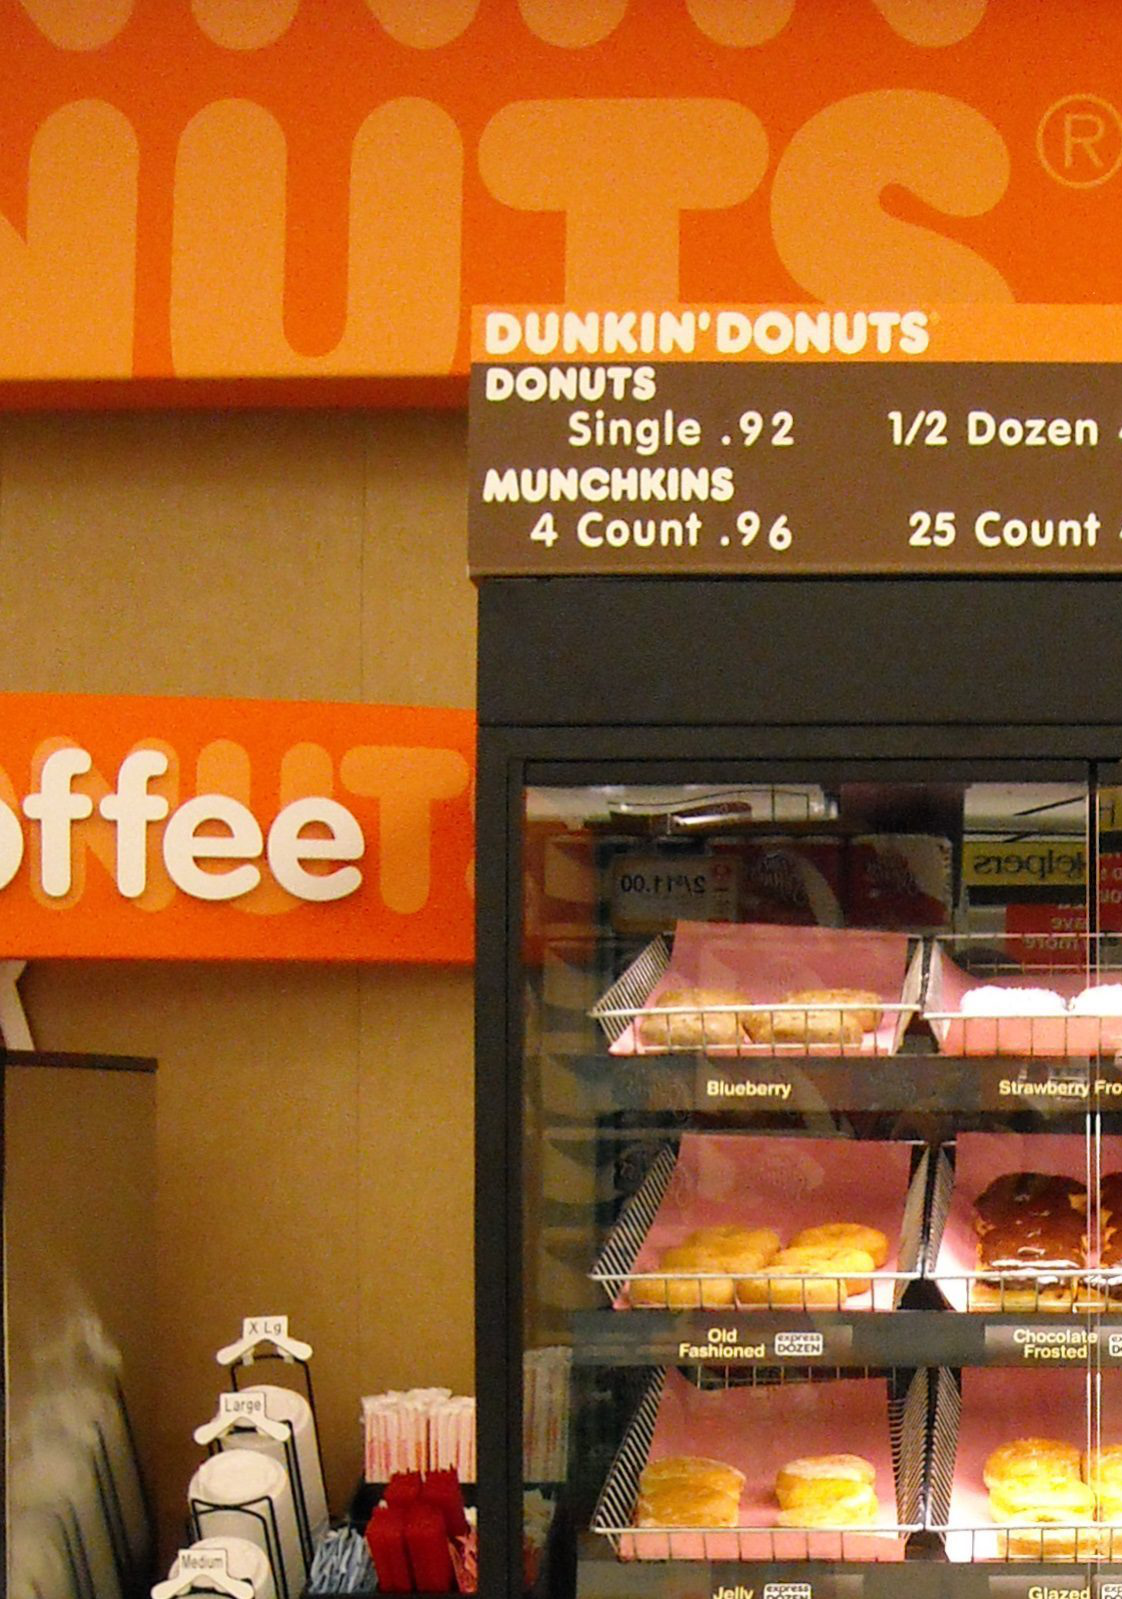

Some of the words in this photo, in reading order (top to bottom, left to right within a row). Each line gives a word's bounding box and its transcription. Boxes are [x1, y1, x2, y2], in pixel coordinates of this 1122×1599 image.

[485, 365, 656, 401] DONUTS
[568, 409, 701, 455] Single
[721, 410, 794, 446] .92
[887, 409, 948, 446] 1/2
[967, 410, 1098, 446] Dozen
[482, 466, 734, 502] MUNCHKINS
[530, 512, 558, 547] 4
[576, 511, 702, 547] Count
[720, 510, 792, 550] .96
[909, 510, 956, 547] 25
[974, 510, 1101, 547] Count
[0, 747, 365, 901] ffee
[706, 1079, 791, 1099] Blueberry
[998, 1078, 1088, 1099] Strawberry
[248, 1321, 259, 1335] X
[263, 1320, 283, 1336] Lg
[707, 1327, 737, 1344] Old
[1013, 1328, 1099, 1343] Chocolate
[777, 1334, 821, 1343] express
[778, 1343, 821, 1353] DOZEN
[679, 1343, 765, 1358] Fashioned
[1023, 1343, 1088, 1359] Frosted
[224, 1397, 262, 1415] Large
[766, 1585, 810, 1594] express
